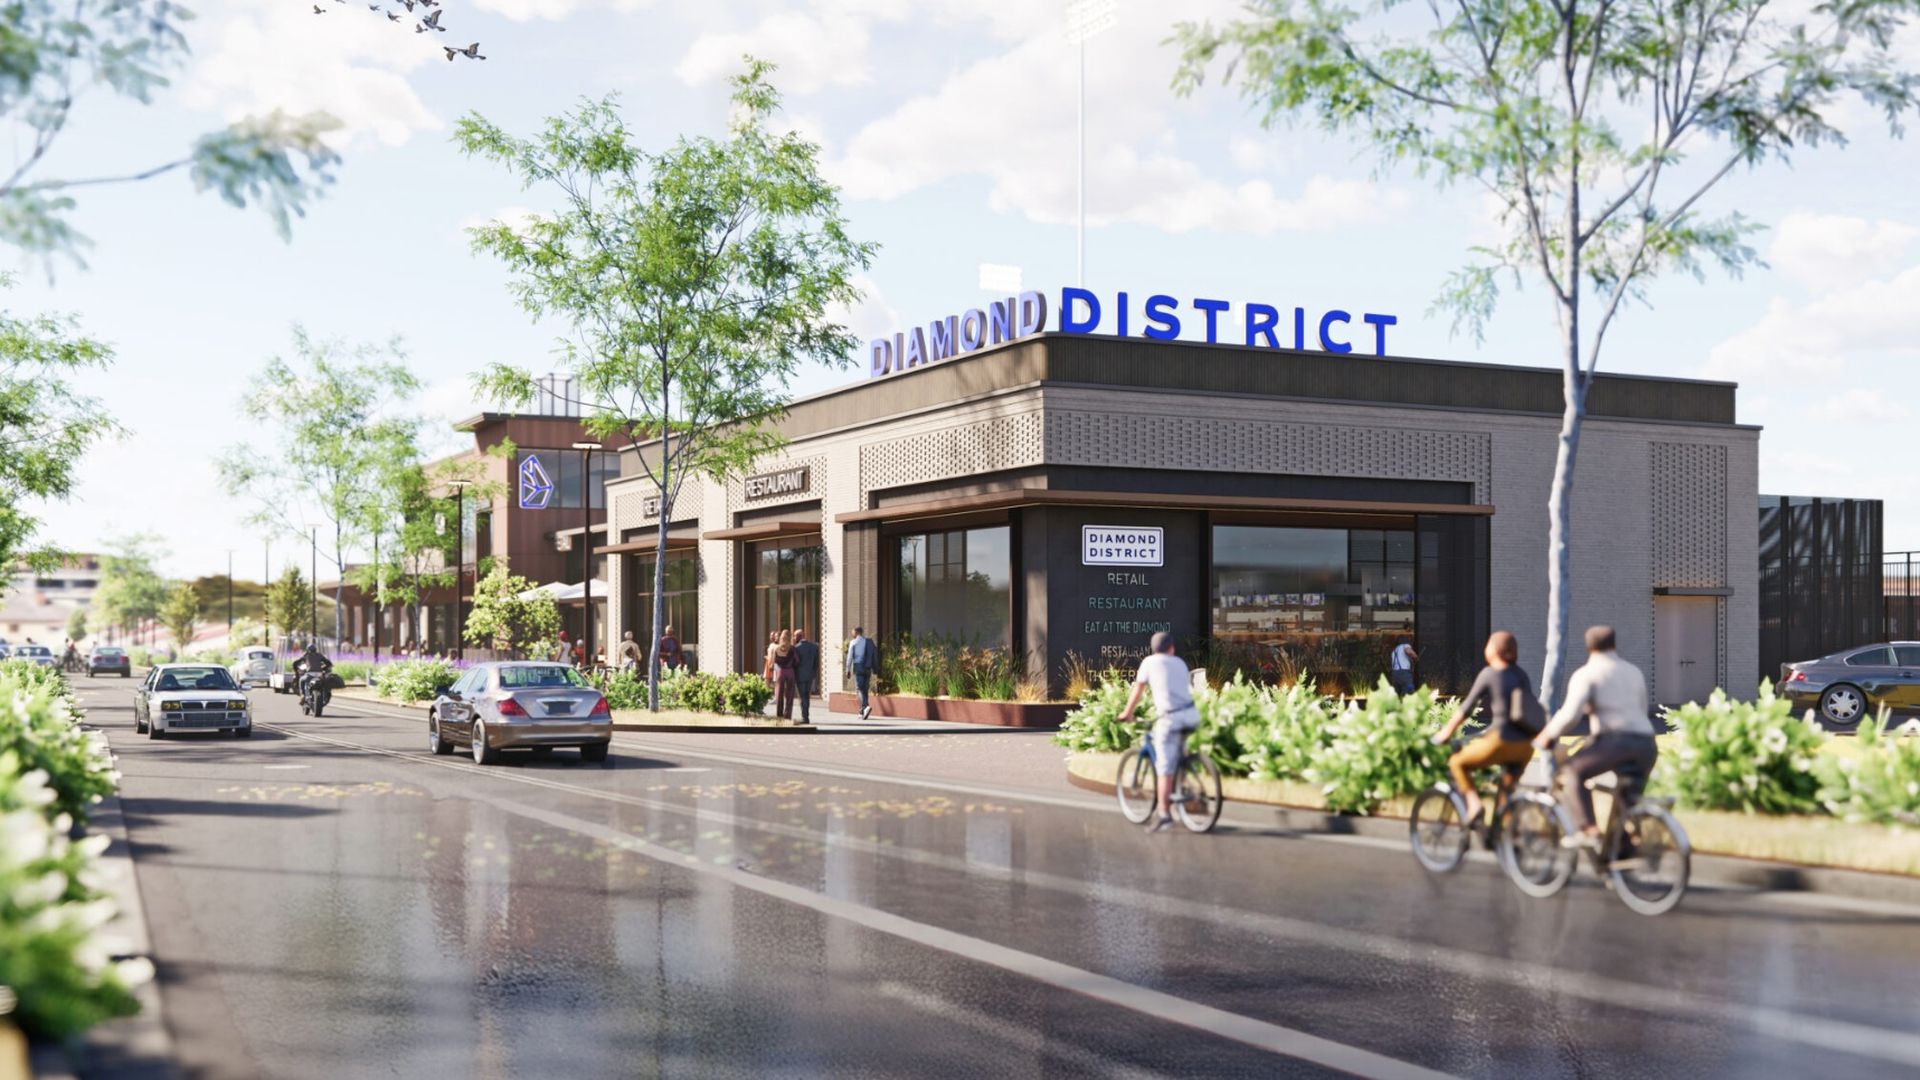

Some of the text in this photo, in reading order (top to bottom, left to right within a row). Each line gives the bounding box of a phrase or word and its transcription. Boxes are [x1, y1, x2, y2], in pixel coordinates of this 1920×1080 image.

[871, 287, 1397, 377] DIAMOND DISTRICT
[745, 470, 805, 497] RESTAURANT
[1090, 534, 1156, 544] DIAMOND
[1090, 548, 1156, 558] DISTRICT
[1107, 573, 1149, 585] RETAIL
[1088, 597, 1168, 609] RESTAURANT
[1085, 621, 1171, 633] EAT AT THE DIAMOND
[1101, 645, 1152, 657] RESTAURAN
